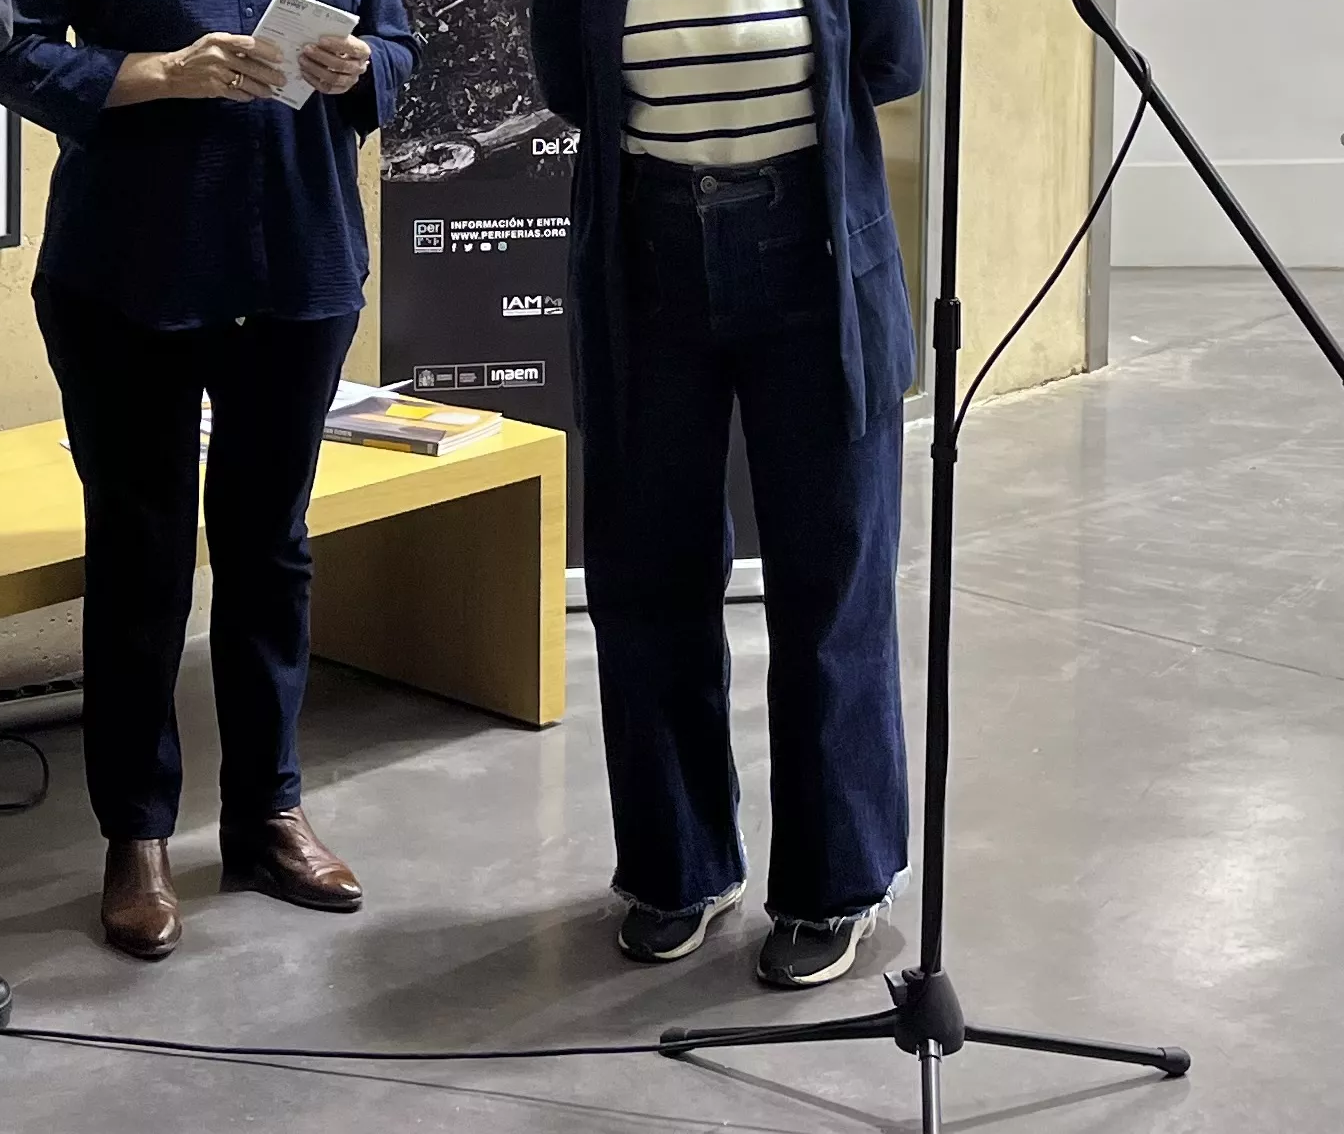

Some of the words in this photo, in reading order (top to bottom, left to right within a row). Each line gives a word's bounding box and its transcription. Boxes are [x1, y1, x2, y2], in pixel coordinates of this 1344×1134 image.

[532, 138, 560, 155] Del
[450, 217, 524, 230] INFORMACIÓN
[526, 218, 534, 227] Y
[450, 228, 567, 241] WWW.PERIFERIAS.ORG
[502, 295, 542, 309] IAM
[491, 368, 538, 382] inaem
